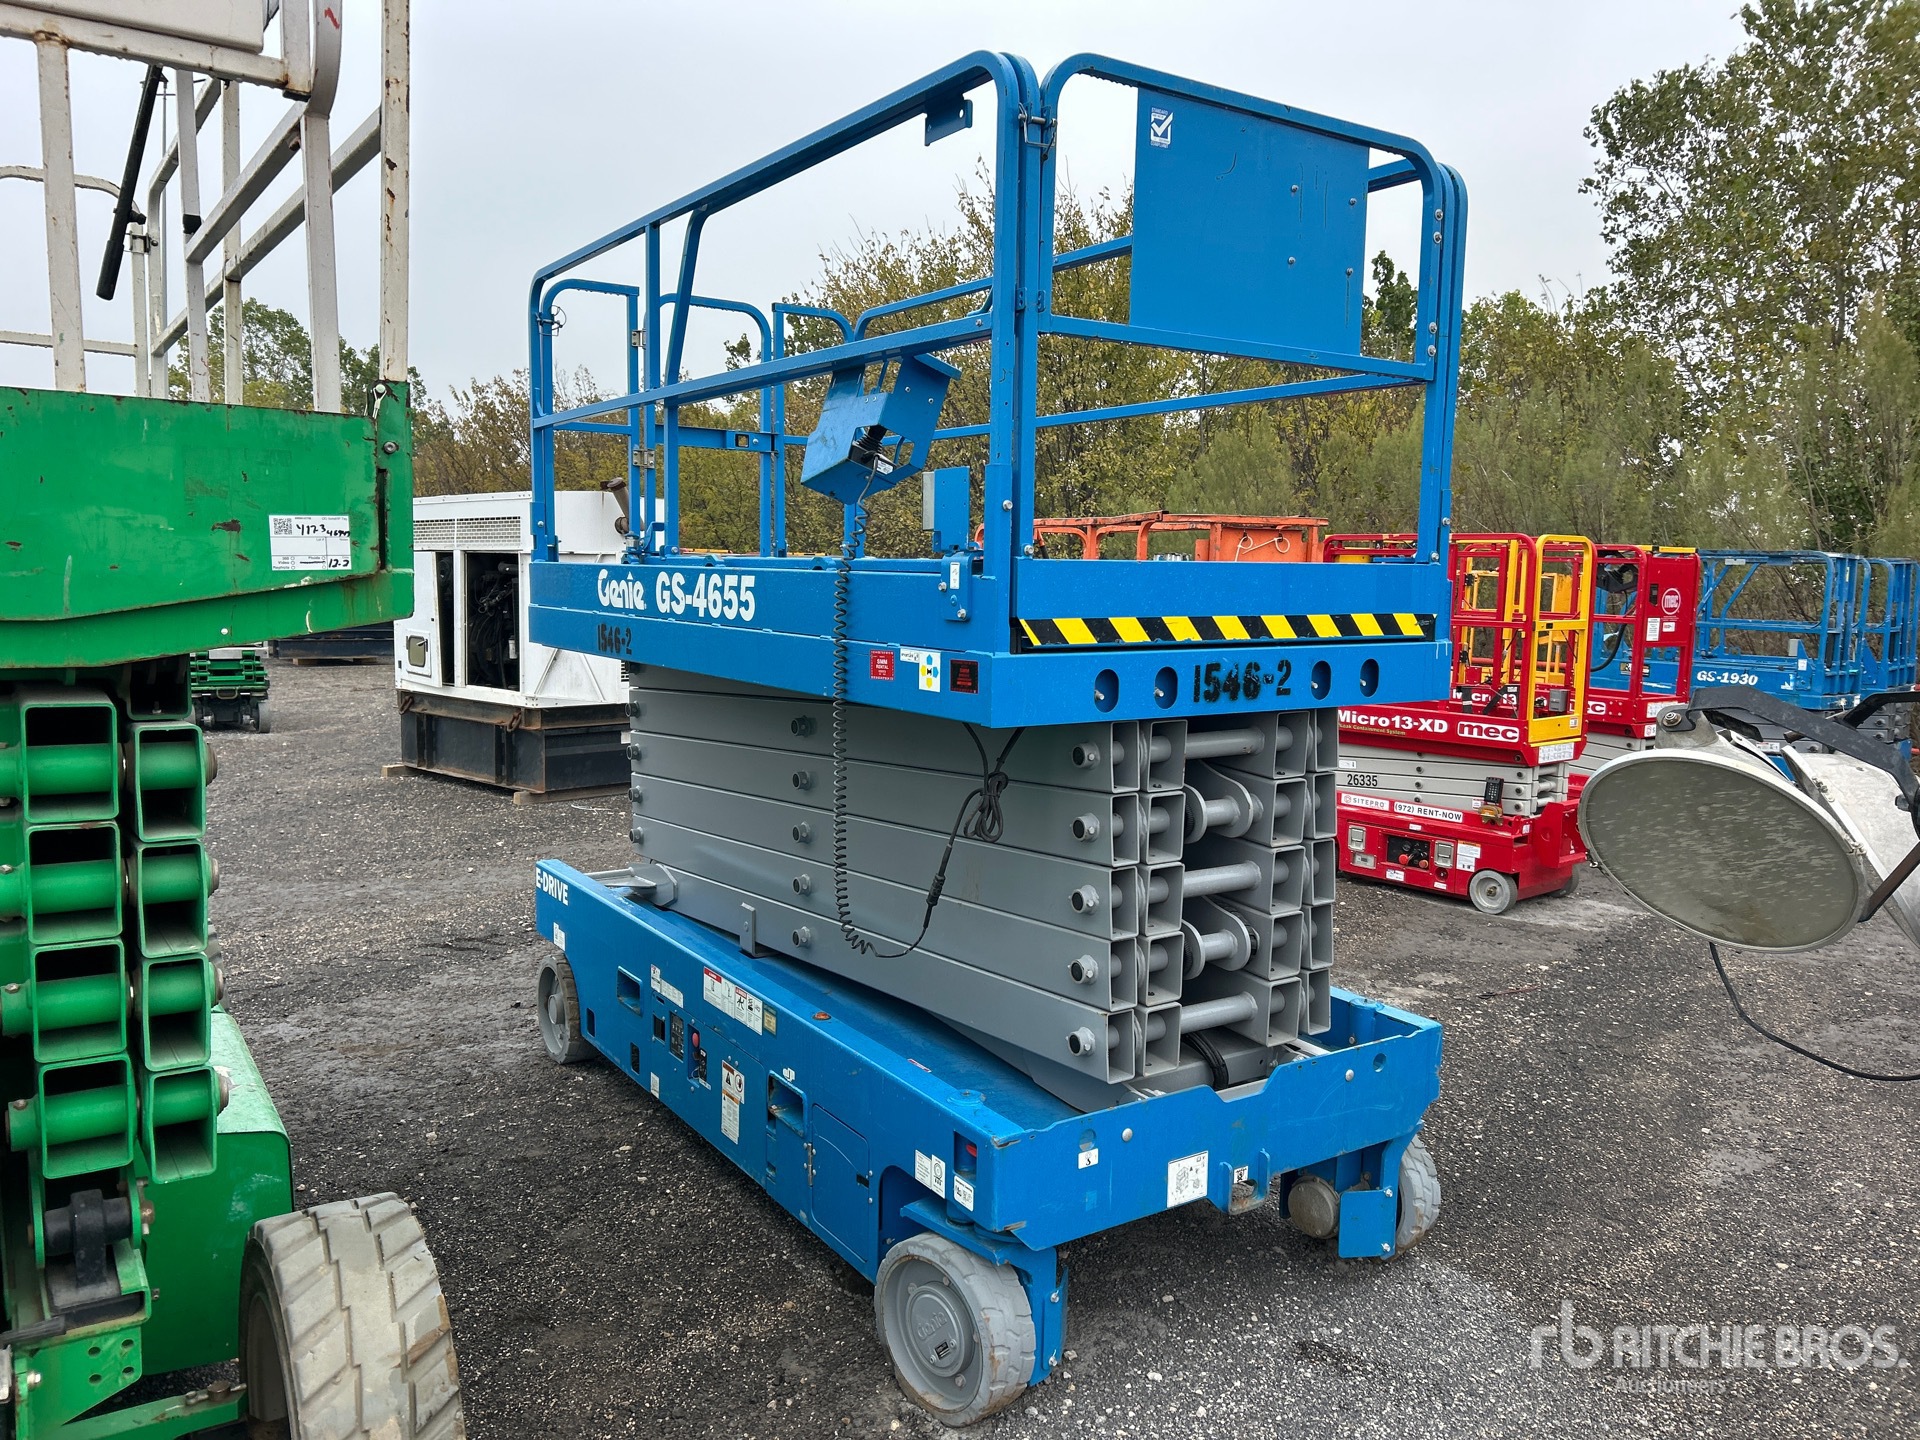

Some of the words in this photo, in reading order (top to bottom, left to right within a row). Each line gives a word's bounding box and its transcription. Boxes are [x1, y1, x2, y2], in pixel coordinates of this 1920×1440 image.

[597, 568, 645, 611] Genie
[655, 571, 756, 622] GS-4655
[597, 623, 632, 655] 1546-2
[1193, 659, 1292, 703] 1546-2
[1696, 670, 1759, 686] GS-1930
[1459, 723, 1518, 740] mec
[1347, 773, 1378, 787] 26335
[1353, 797, 1385, 808] SITEPRO
[1394, 803, 1415, 814] (972)
[1417, 807, 1462, 821] RENT-NOW
[535, 866, 569, 906] E-DRIVE
